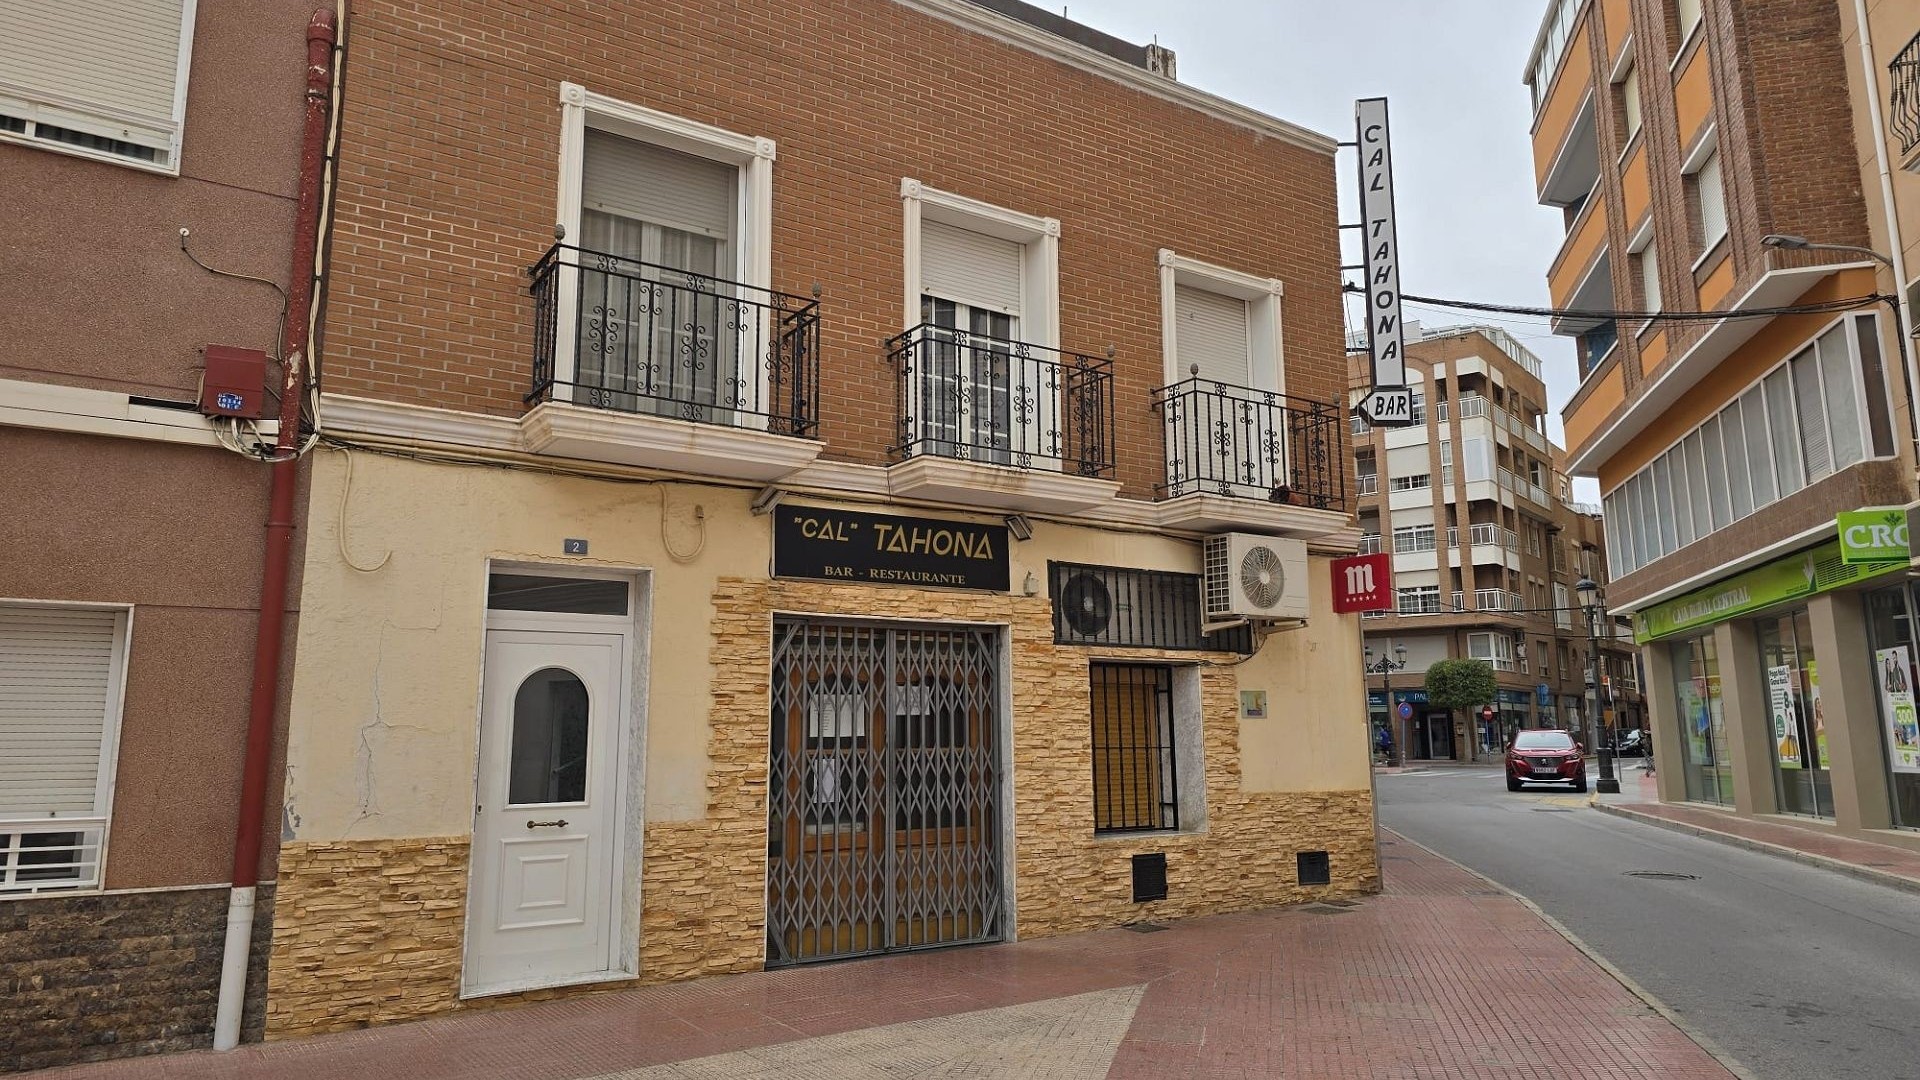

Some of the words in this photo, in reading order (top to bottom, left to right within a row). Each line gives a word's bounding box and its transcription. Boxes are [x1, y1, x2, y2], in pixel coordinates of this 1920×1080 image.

[1364, 125, 1385, 192] CAL
[1371, 218, 1397, 360] TAHONA
[1375, 395, 1407, 416] BAR
[572, 541, 580, 552] 2
[873, 523, 994, 560] TAHONA
[824, 565, 854, 578] BAR
[870, 567, 966, 585] RESTAURANTE
